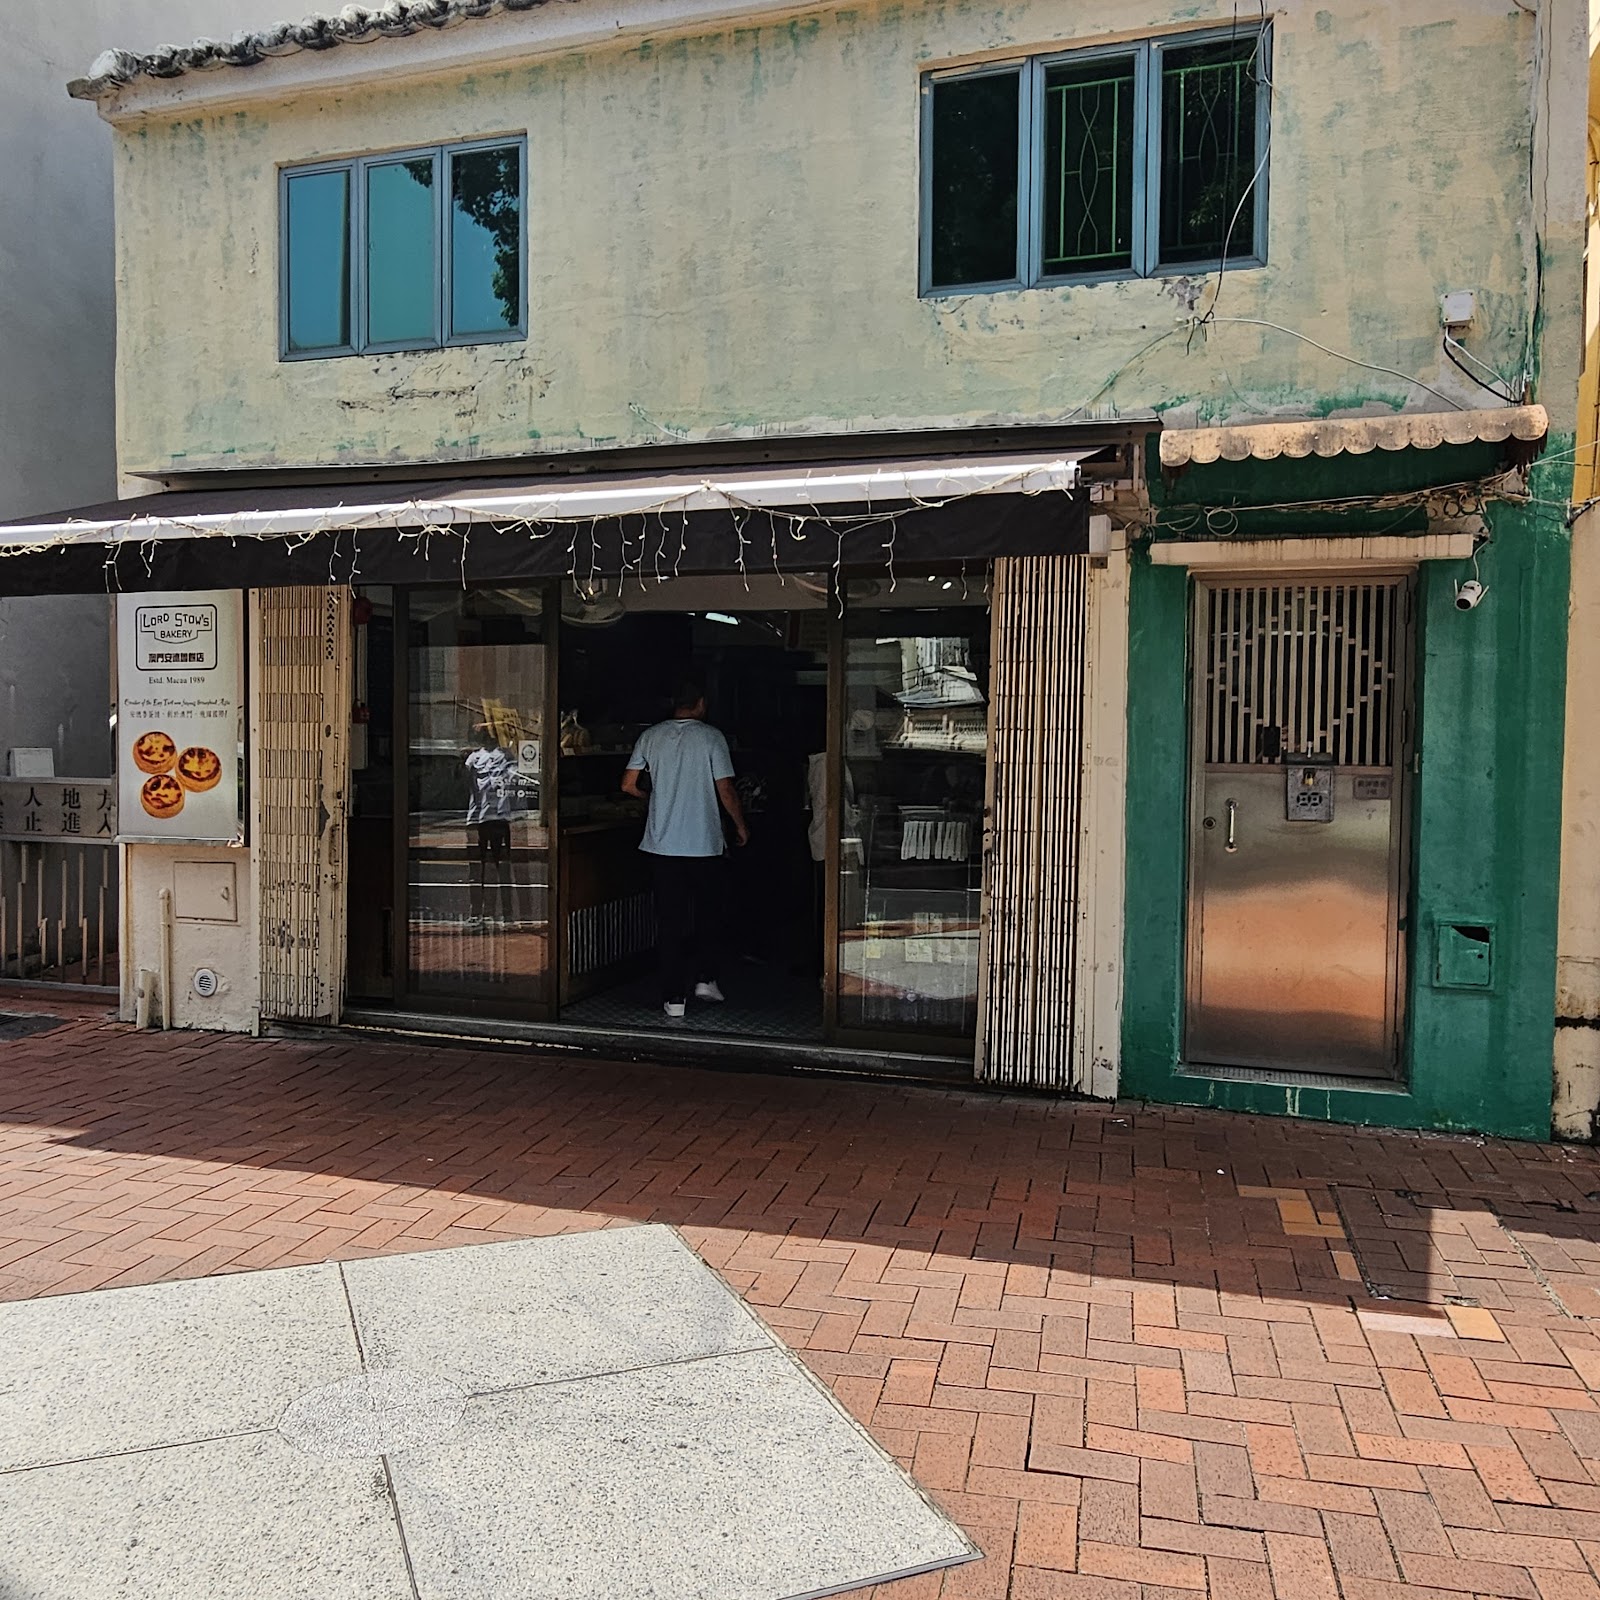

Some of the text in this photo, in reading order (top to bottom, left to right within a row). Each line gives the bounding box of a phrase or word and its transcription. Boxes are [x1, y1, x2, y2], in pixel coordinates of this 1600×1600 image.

[143, 612, 210, 628] LORD STOW'S
[160, 629, 193, 639] BAKERY
[189, 676, 205, 684] 1989
